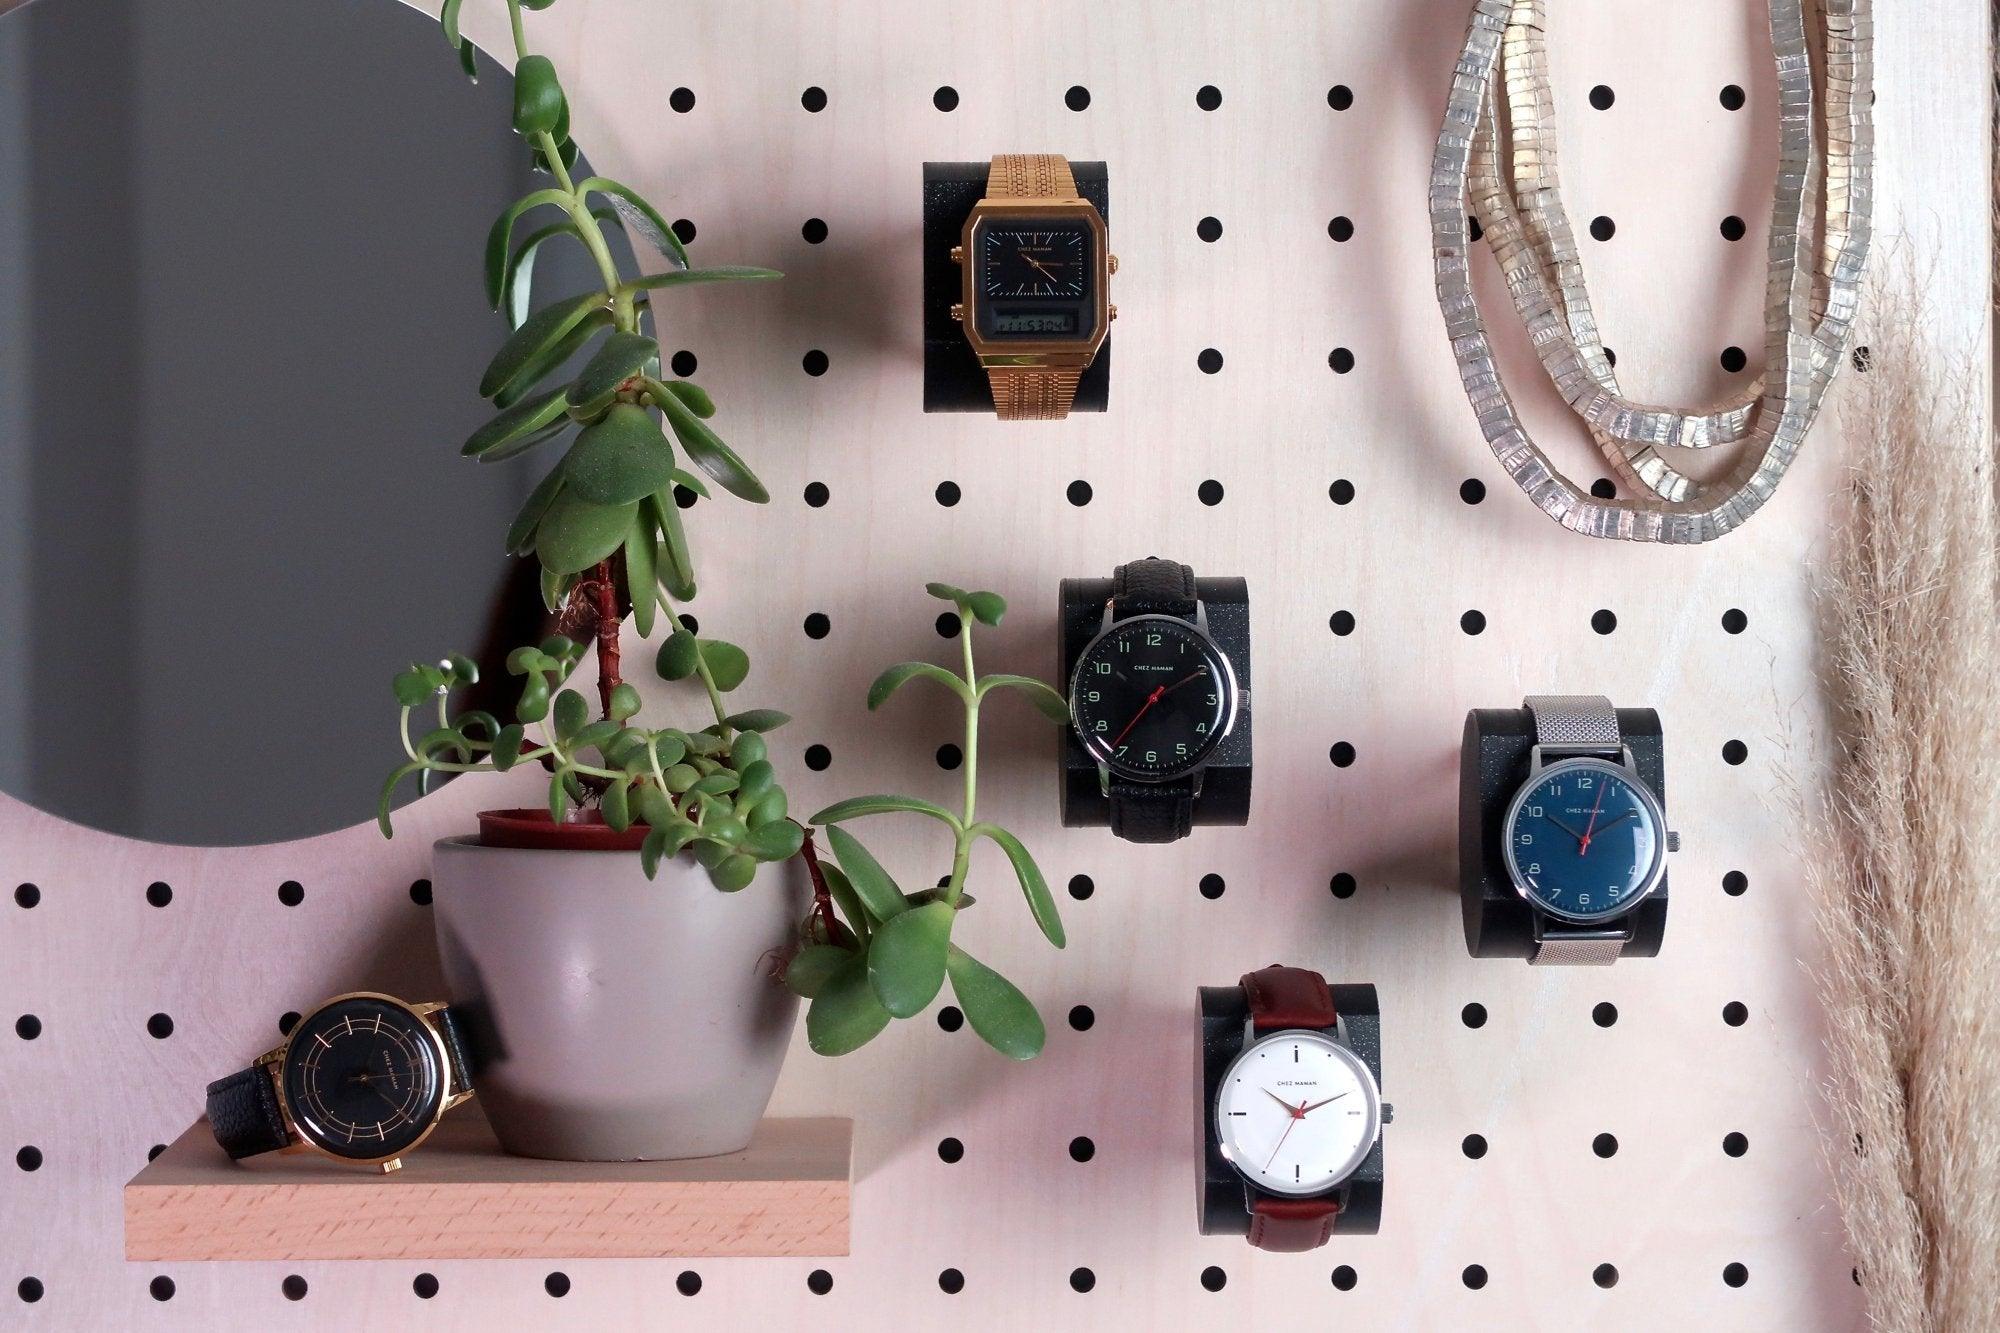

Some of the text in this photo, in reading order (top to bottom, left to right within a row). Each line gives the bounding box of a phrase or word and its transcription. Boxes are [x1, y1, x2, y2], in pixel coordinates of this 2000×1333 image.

[1146, 634, 1162, 646] 12
[1119, 641, 1130, 653] 11
[1180, 643, 1184, 654] 1
[1096, 663, 1111, 674] 10
[1198, 664, 1207, 676] 2
[1088, 691, 1100, 702] 9
[1206, 694, 1217, 706] 3
[1096, 720, 1108, 732] 8
[1195, 722, 1207, 734] 4
[1118, 745, 1129, 757] 7
[1176, 743, 1187, 755] 5
[1145, 751, 1157, 762] 6
[1577, 778, 1593, 789] 12
[1550, 785, 1561, 796] 11
[1611, 786, 1615, 797] 1
[1527, 806, 1543, 818] 10
[1521, 834, 1533, 845] 9
[1528, 862, 1541, 875] 8
[1551, 888, 1562, 899] 7
[1608, 885, 1619, 897] 5
[1578, 893, 1590, 905] 6
[383, 1050, 393, 1068] CHEZ
